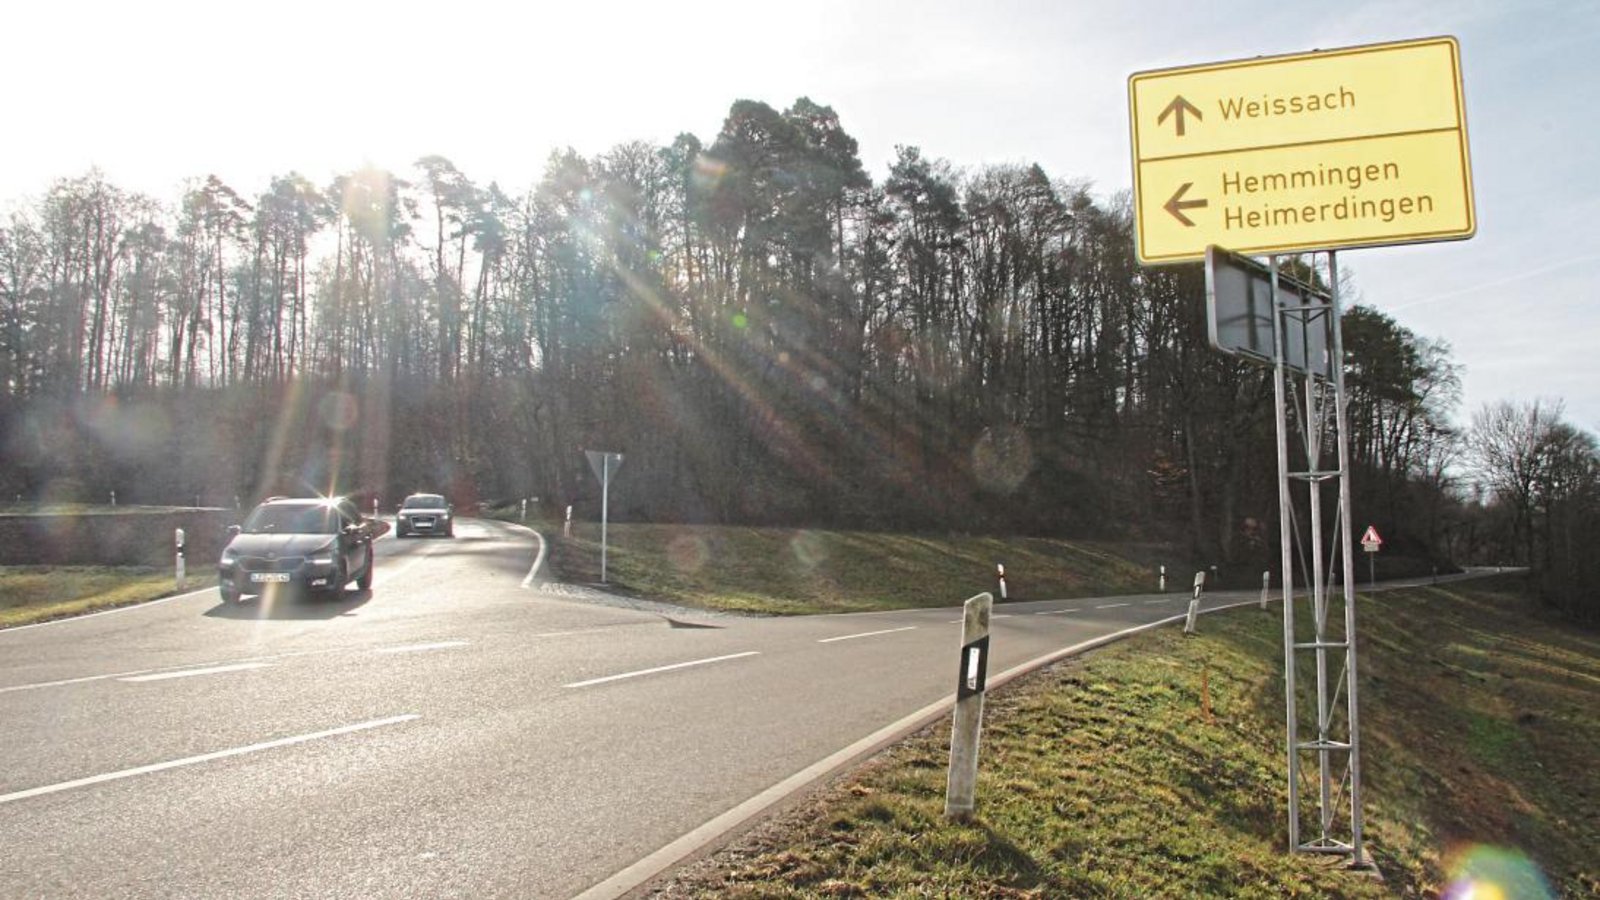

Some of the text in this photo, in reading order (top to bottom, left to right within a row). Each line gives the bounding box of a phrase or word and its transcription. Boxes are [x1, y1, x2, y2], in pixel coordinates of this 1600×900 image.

[1219, 87, 1355, 120] Weissach
[1222, 162, 1399, 195] Hemmingen
[1224, 195, 1433, 230] Heimerdingen
